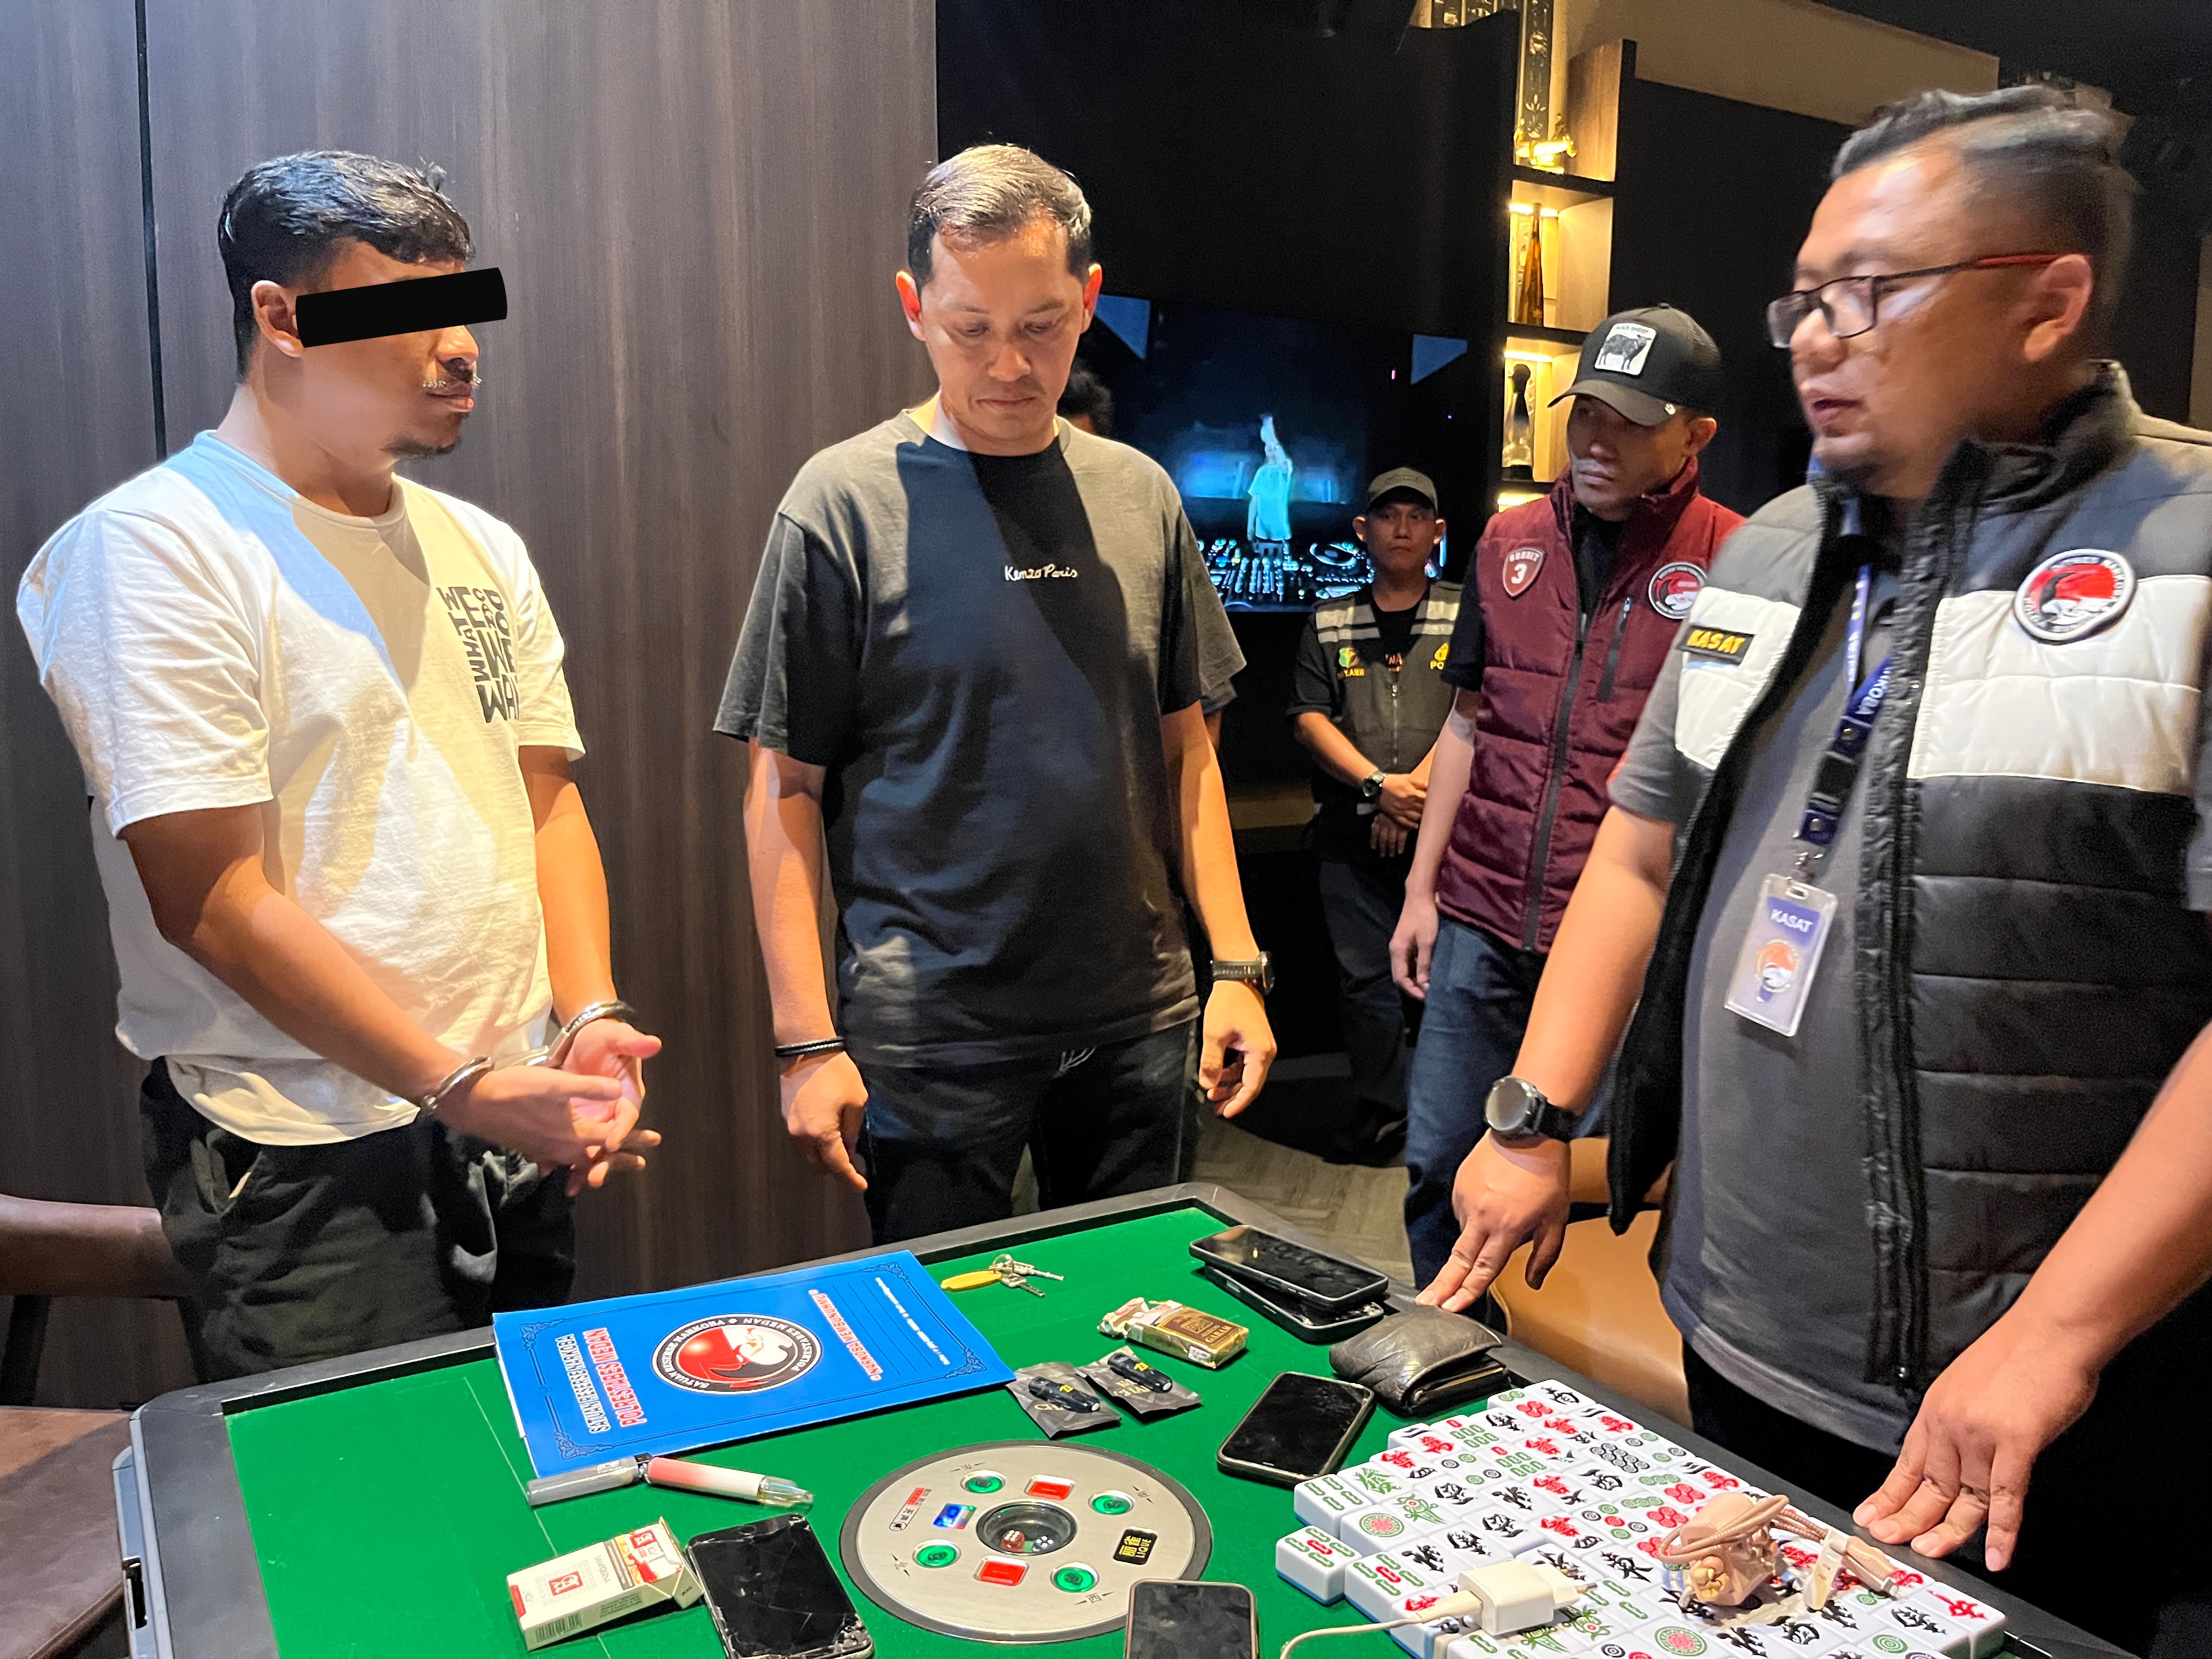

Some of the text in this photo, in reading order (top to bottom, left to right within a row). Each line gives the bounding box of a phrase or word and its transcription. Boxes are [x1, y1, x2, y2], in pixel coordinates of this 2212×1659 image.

[1511, 563, 1527, 584] 3
[1687, 629, 1745, 654] KASAT
[1770, 909, 1814, 933] KASAT
[673, 1319, 726, 1342] NARKOBA
[811, 1293, 883, 1375] NARKOBA MEMBUNUHMU
[1205, 1325, 1232, 1343] GARAM
[555, 1333, 586, 1372] NARKOBA
[583, 1327, 619, 1364] MEDAN
[567, 1369, 600, 1404] RESERSE
[669, 1369, 710, 1389] SATUAN
[595, 1361, 647, 1427] POLRESTABES
[1541, 1385, 1579, 1405] 南
[579, 1401, 611, 1434] SATUAN
[1485, 1412, 1525, 1434] 南
[1354, 1466, 1402, 1494] 發
[1578, 1469, 1623, 1491] 西
[1434, 1482, 1480, 1505] 西
[1491, 1486, 1534, 1511] 北
[1482, 1514, 1528, 1537] 西
[1135, 1538, 1152, 1558] LIQUE
[1446, 1530, 1492, 1558] 南
[1401, 1544, 1445, 1573] 北
[1600, 1550, 1654, 1583] 東
[1085, 1592, 1102, 1604] 西
[1768, 1615, 1820, 1645] 西
[1891, 1606, 1948, 1635] 南
